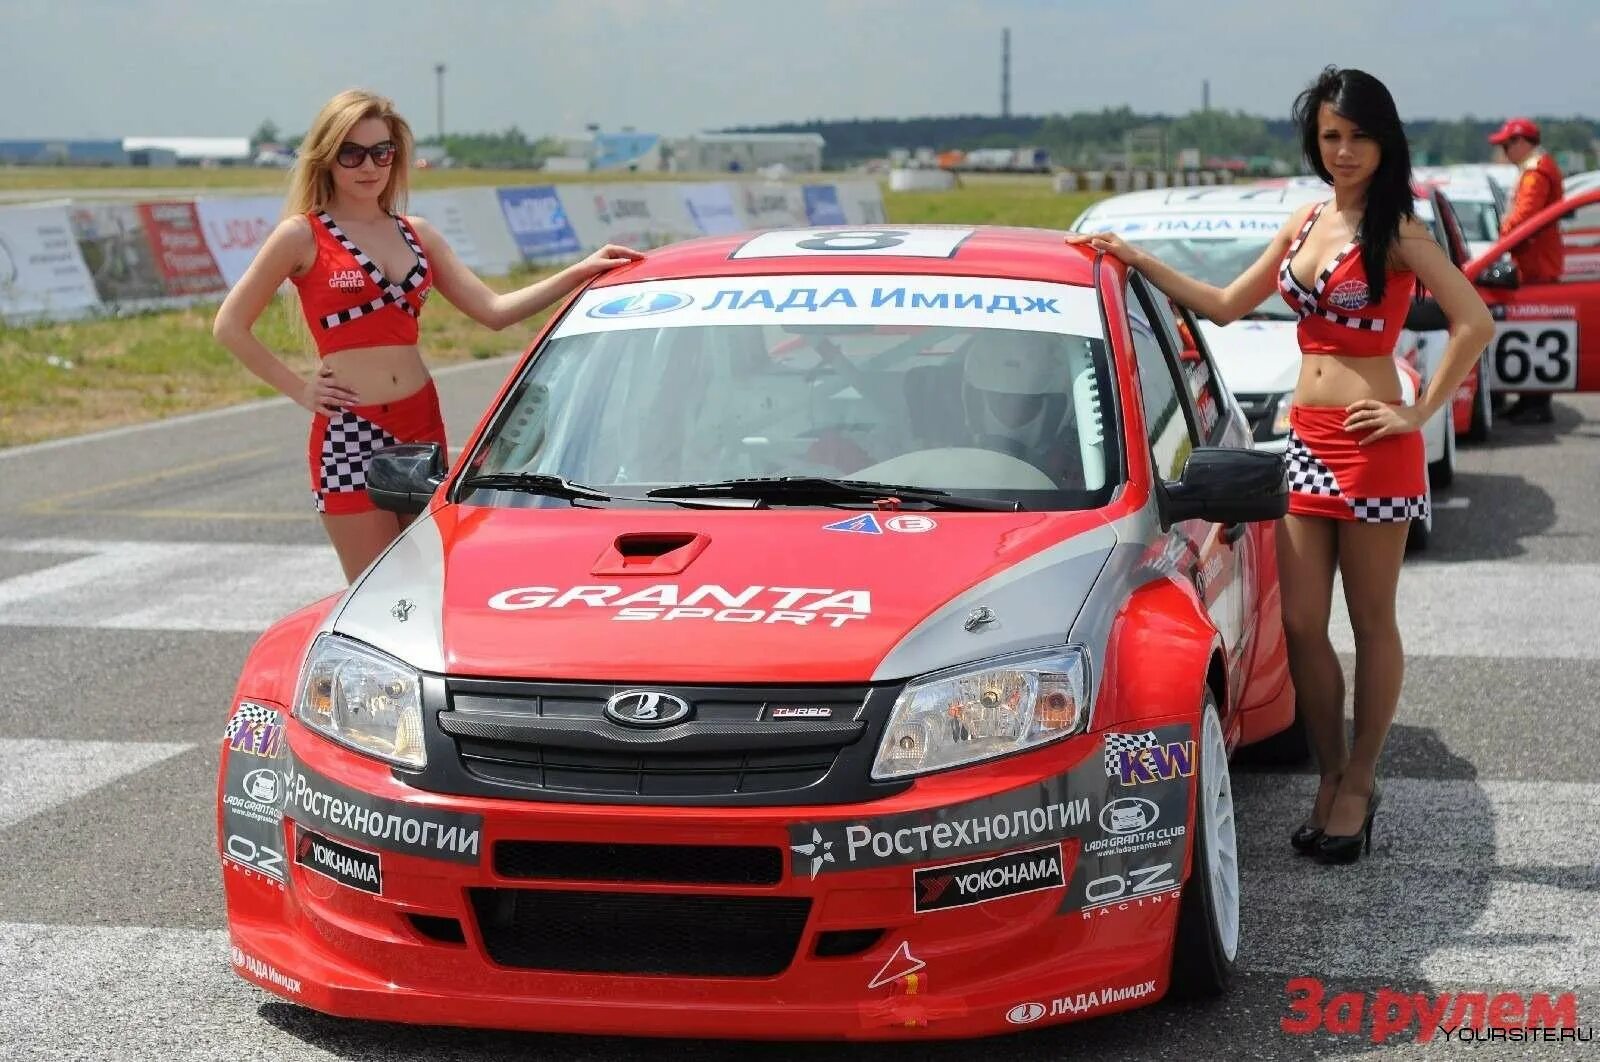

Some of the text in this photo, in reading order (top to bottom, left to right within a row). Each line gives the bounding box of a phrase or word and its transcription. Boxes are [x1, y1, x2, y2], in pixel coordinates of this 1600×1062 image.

[795, 230, 910, 251] 8
[328, 278, 365, 288] Granta
[333, 270, 363, 280] LADA
[701, 287, 1061, 315] ЛАДА Имидж
[1495, 330, 1571, 384] 63
[487, 584, 873, 614] GRANTA
[610, 607, 871, 628] SPORT
[772, 708, 832, 717] TURBO
[1119, 741, 1197, 787] KW
[295, 774, 480, 856] Ростехнологии
[846, 798, 1091, 862] Ростехнологии
[1084, 825, 1186, 852] LADA GRANTA CLUB
[1096, 838, 1172, 857] www.ladagranta.net
[312, 842, 378, 884] YOKOHAMA
[955, 857, 1061, 896] YOKOHAMA
[1082, 891, 1181, 920] RACING
[246, 954, 269, 980] ЛАДА
[1050, 980, 1156, 1017] ЛАДА Имидж
